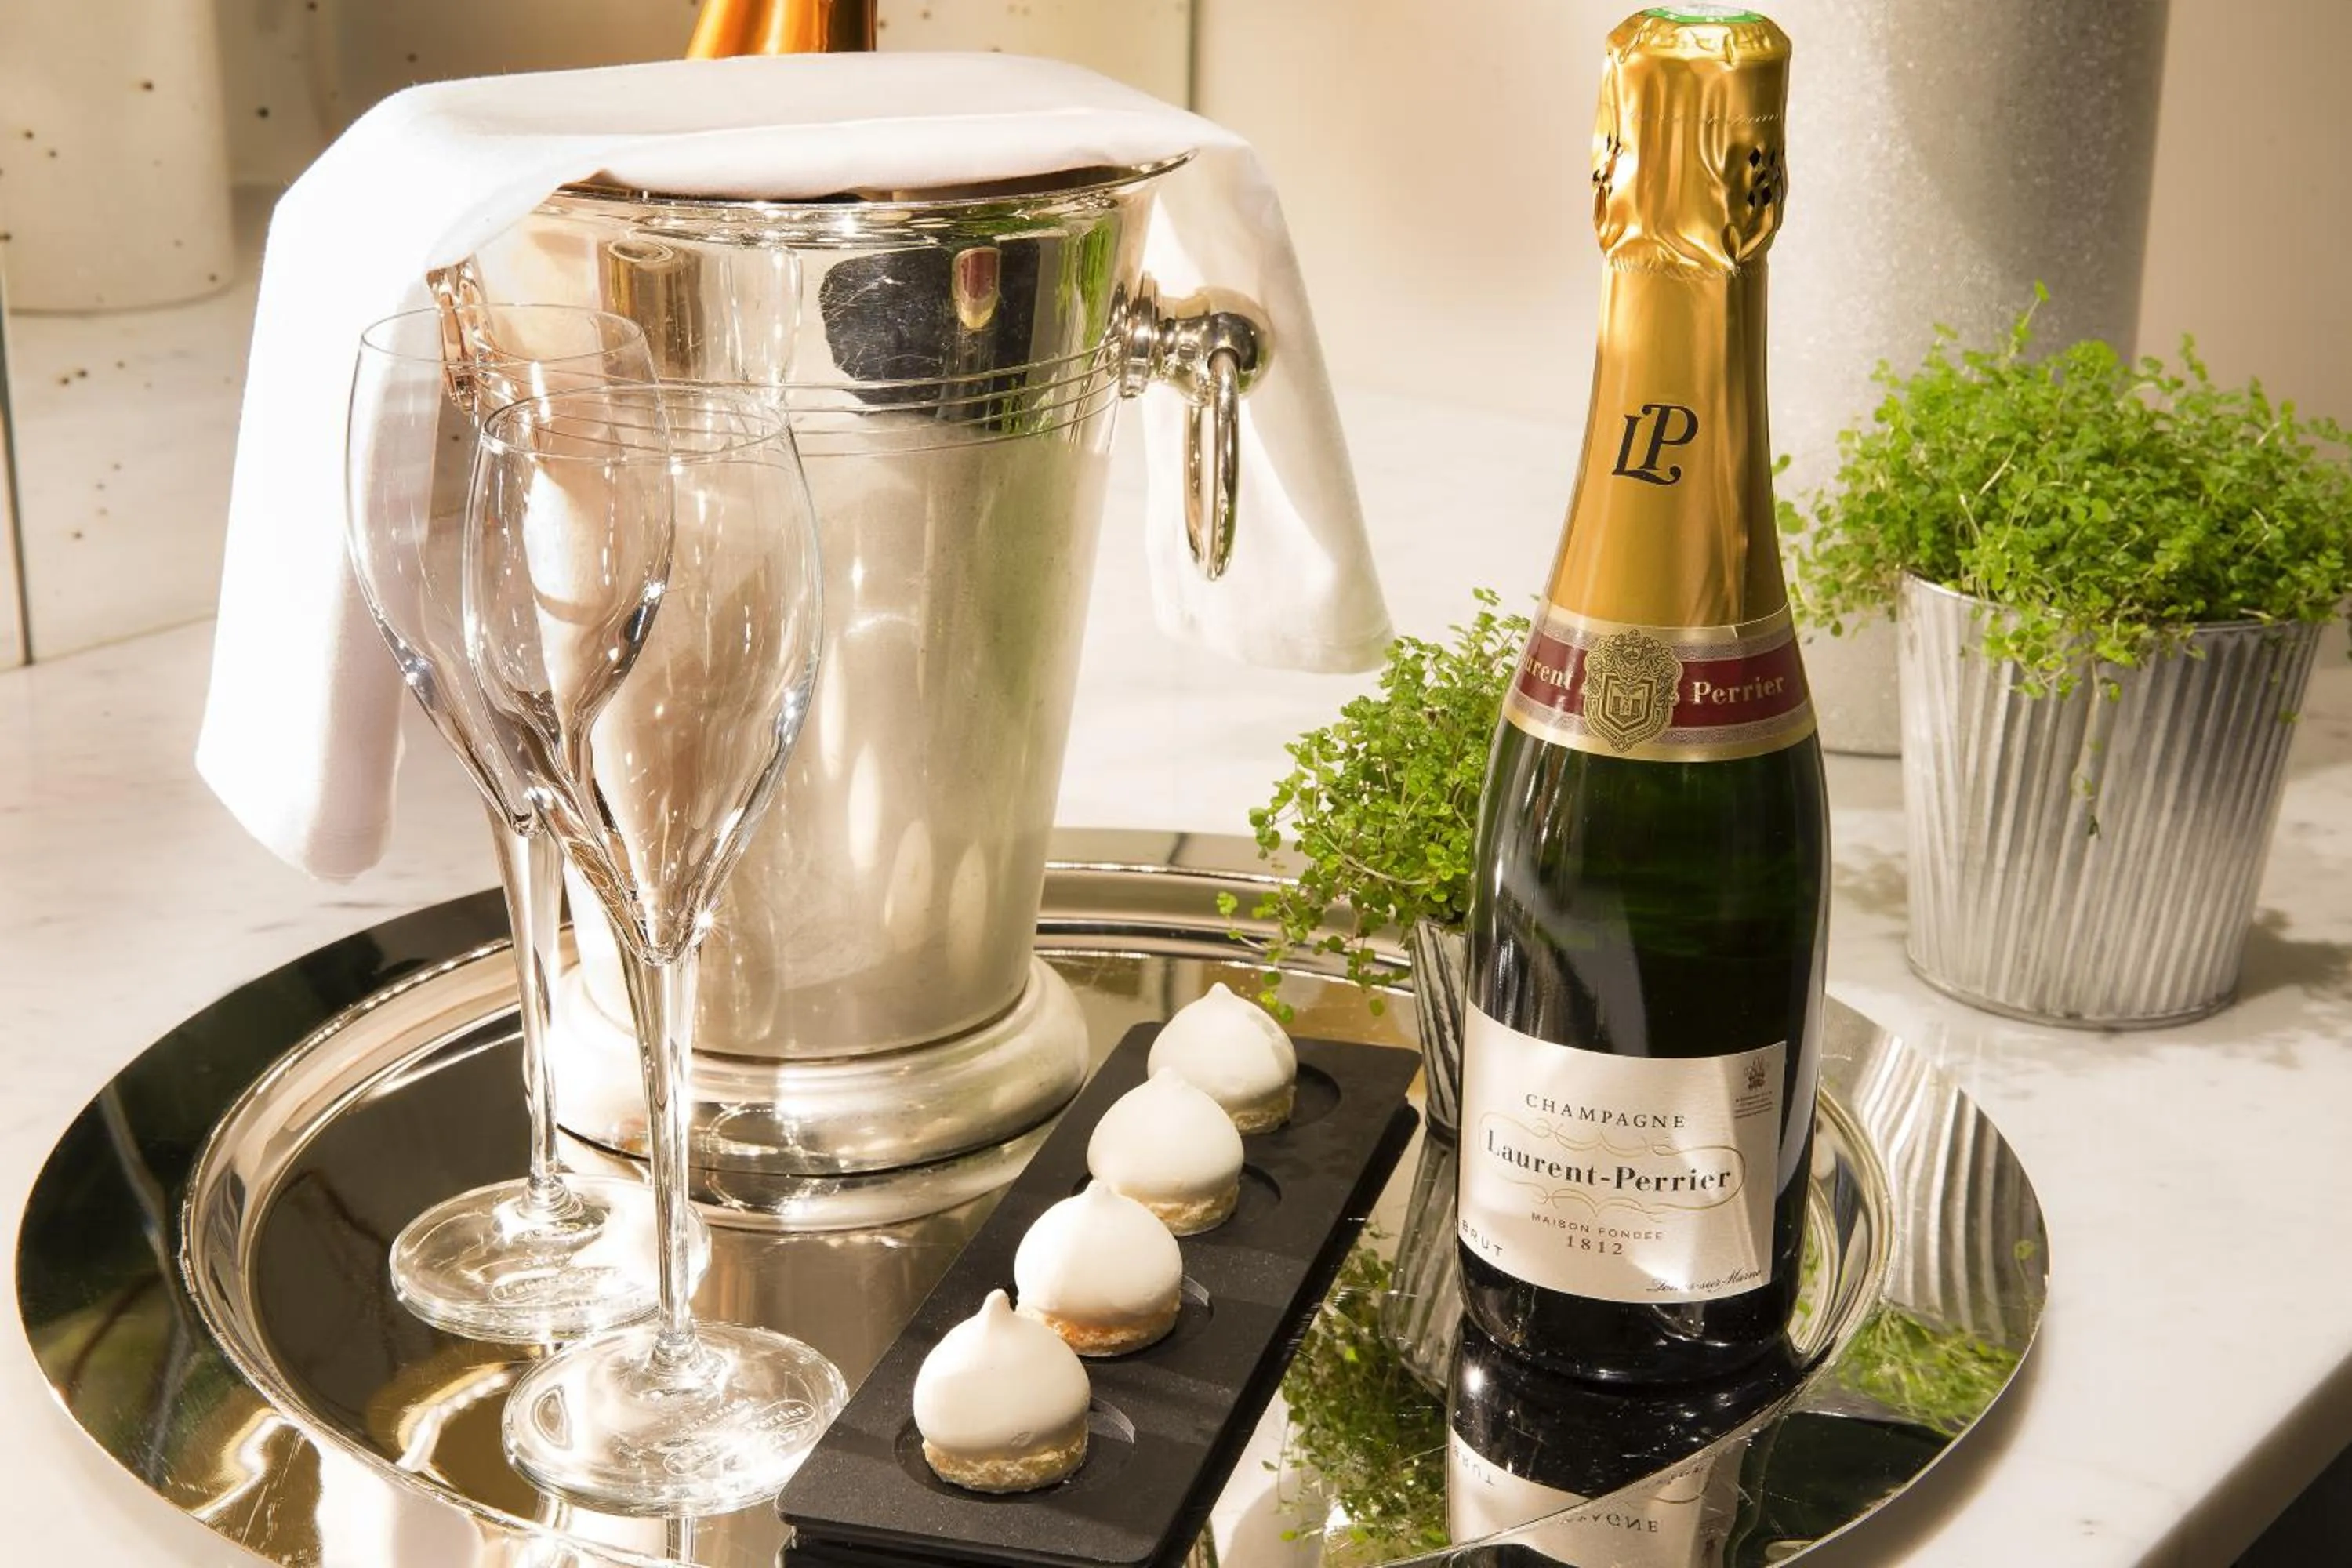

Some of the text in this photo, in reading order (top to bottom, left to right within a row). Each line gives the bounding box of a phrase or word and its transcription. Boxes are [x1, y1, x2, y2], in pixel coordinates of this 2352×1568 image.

[1612, 403, 1698, 485] LP
[1523, 655, 1784, 705] urent Perrier
[1526, 1094, 1686, 1129] CHAMPAGNE
[1486, 1129, 1730, 1192] Laurent-Perrier
[1461, 1219, 1503, 1257] BRUT
[1531, 1212, 1590, 1233] MAISON
[1567, 1235, 1623, 1255] 1812
